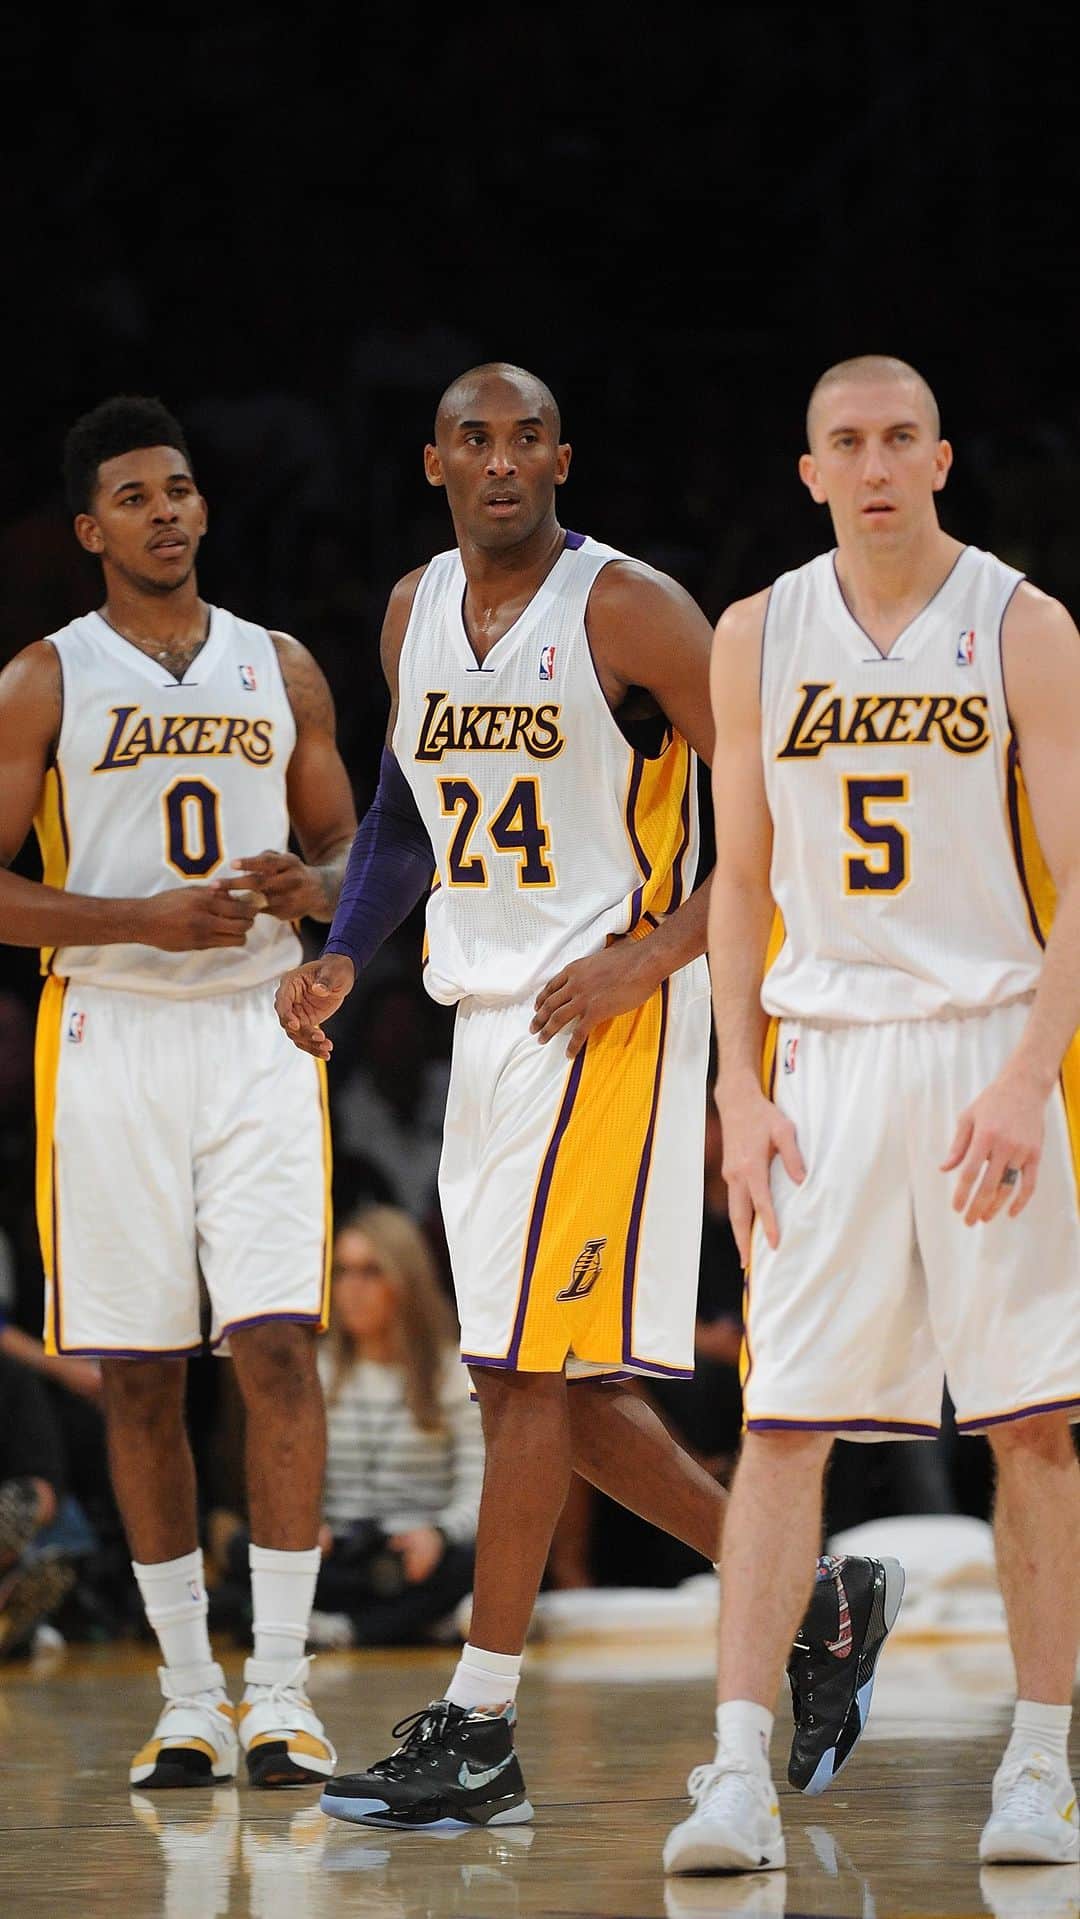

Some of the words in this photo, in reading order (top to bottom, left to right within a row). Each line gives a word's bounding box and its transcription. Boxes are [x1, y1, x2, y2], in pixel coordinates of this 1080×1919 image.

[91, 704, 275, 774] LAKERS
[414, 689, 567, 763] LAKERS
[774, 680, 993, 761] LAKERS
[161, 775, 224, 880] 0
[436, 776, 556, 889] 24
[841, 773, 912, 896] 5
